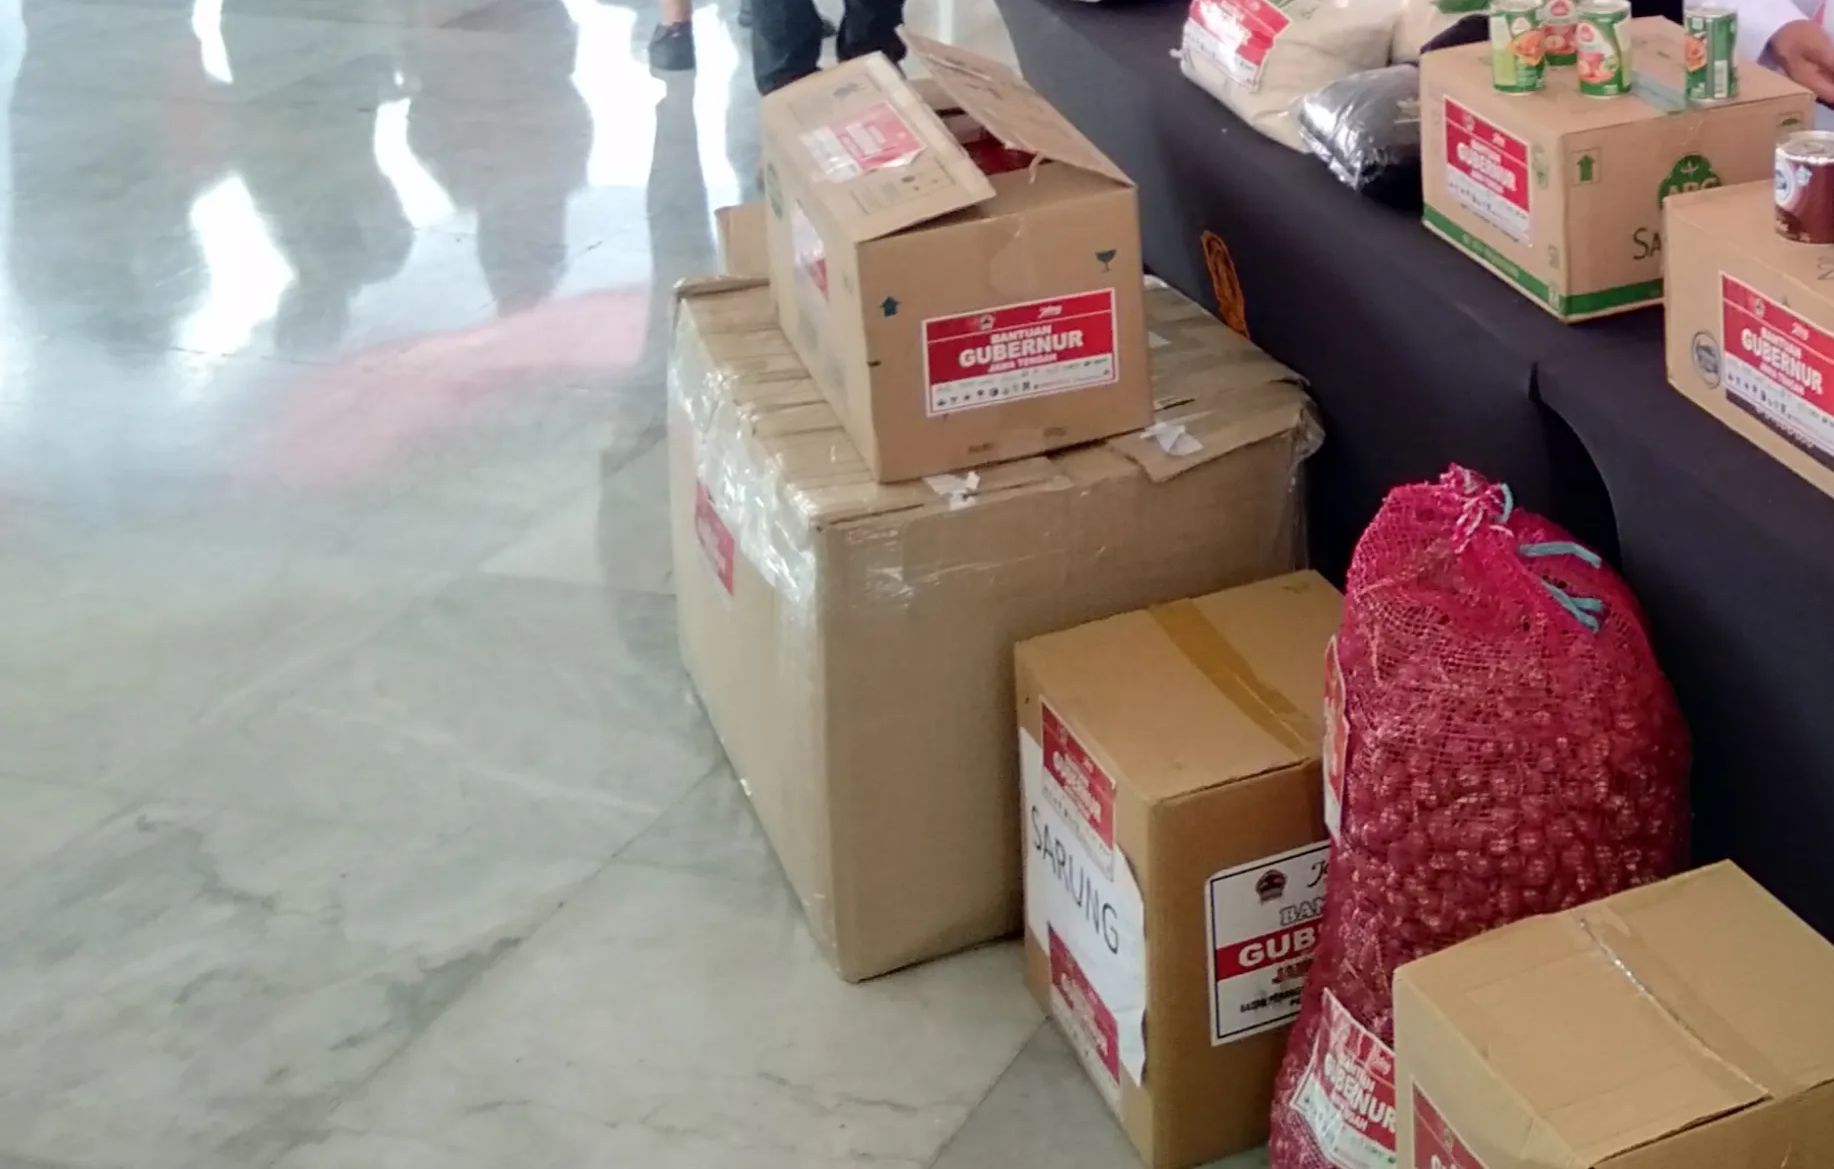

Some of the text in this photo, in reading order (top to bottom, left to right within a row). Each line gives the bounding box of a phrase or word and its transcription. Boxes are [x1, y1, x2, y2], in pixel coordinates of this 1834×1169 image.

[959, 330, 1084, 367] GUBERNUR
[1741, 328, 1823, 395] GUBERNUR
[1031, 805, 1120, 955] SARUNG
[1280, 897, 1325, 926] BAN
[1238, 926, 1319, 969] GUB
